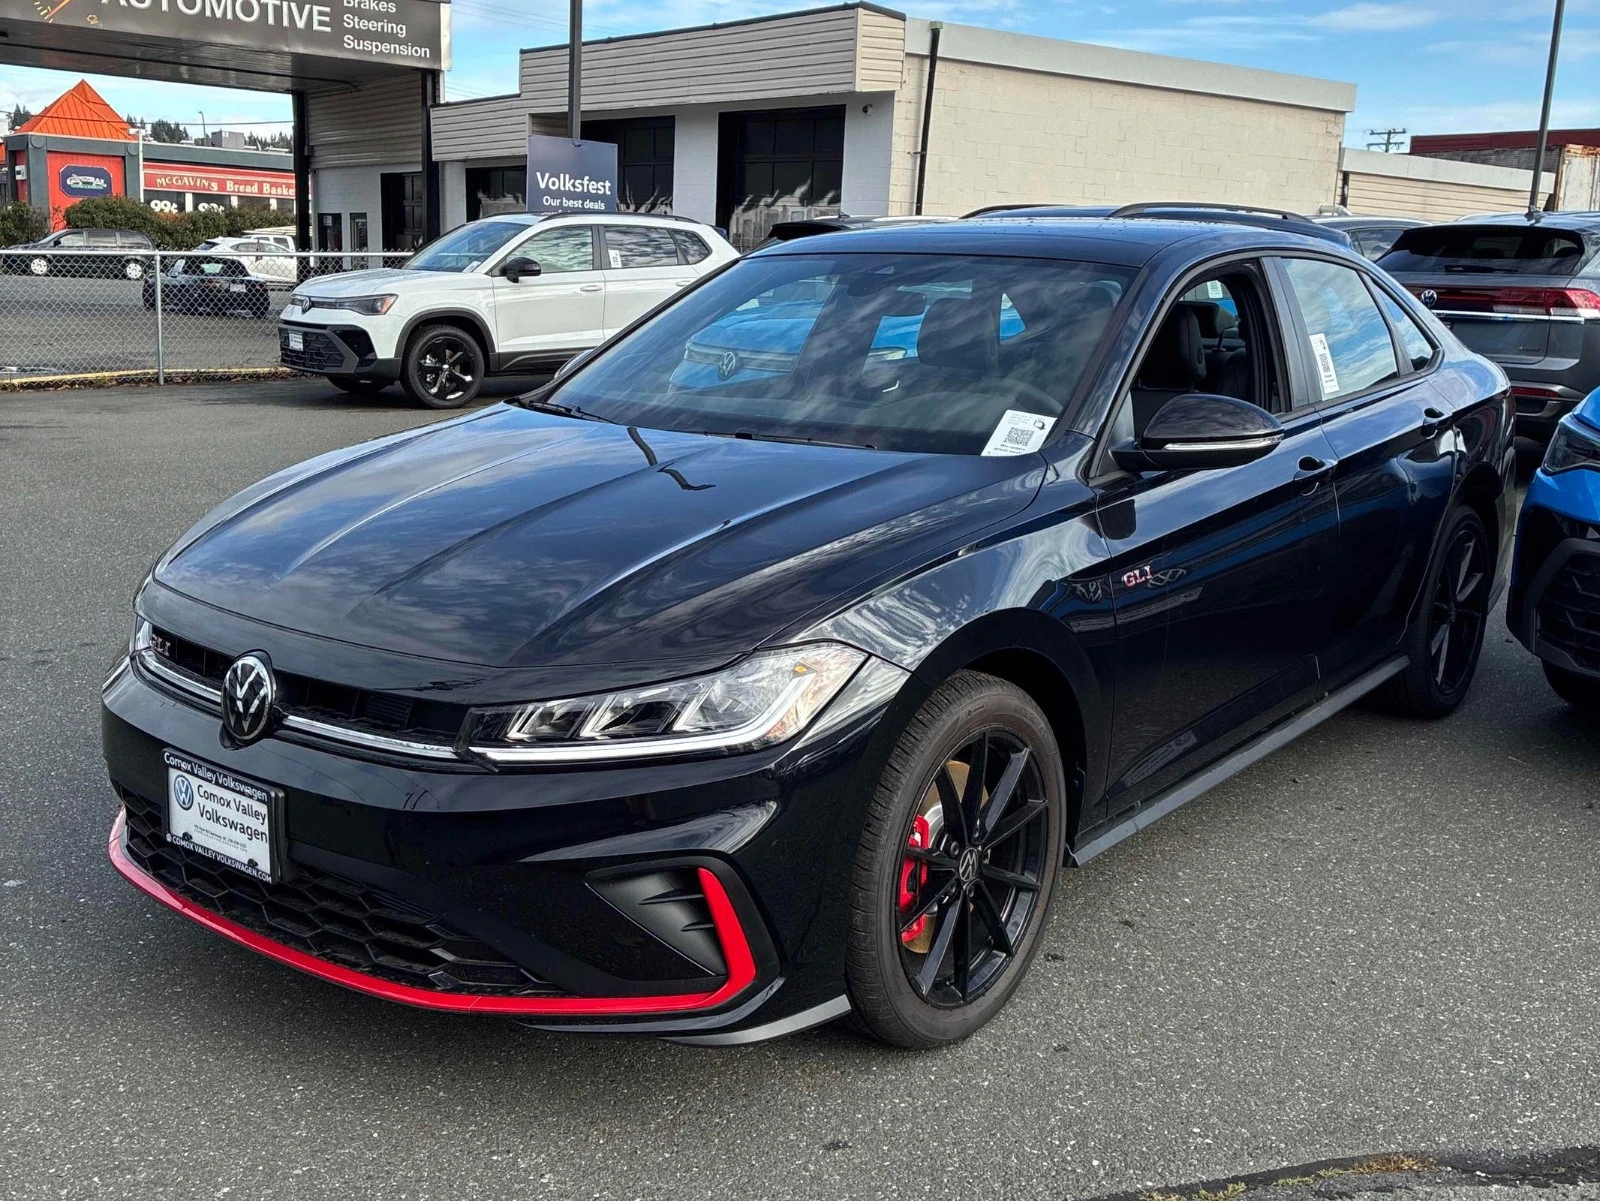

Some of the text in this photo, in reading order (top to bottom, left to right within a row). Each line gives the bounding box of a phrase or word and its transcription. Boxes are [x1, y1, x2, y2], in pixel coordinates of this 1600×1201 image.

[102, 0, 331, 32] OMOTIVE
[343, 14, 406, 38] Steering
[343, 35, 430, 58] Suspension
[226, 181, 259, 193] Bread
[536, 172, 611, 195] Volksfest
[543, 196, 605, 210] Our best deals
[1122, 565, 1153, 587] GLI
[164, 752, 268, 802] Comox Valley Volkswagen
[197, 784, 266, 825] Comox Valley
[198, 802, 268, 843] Volkswagen
